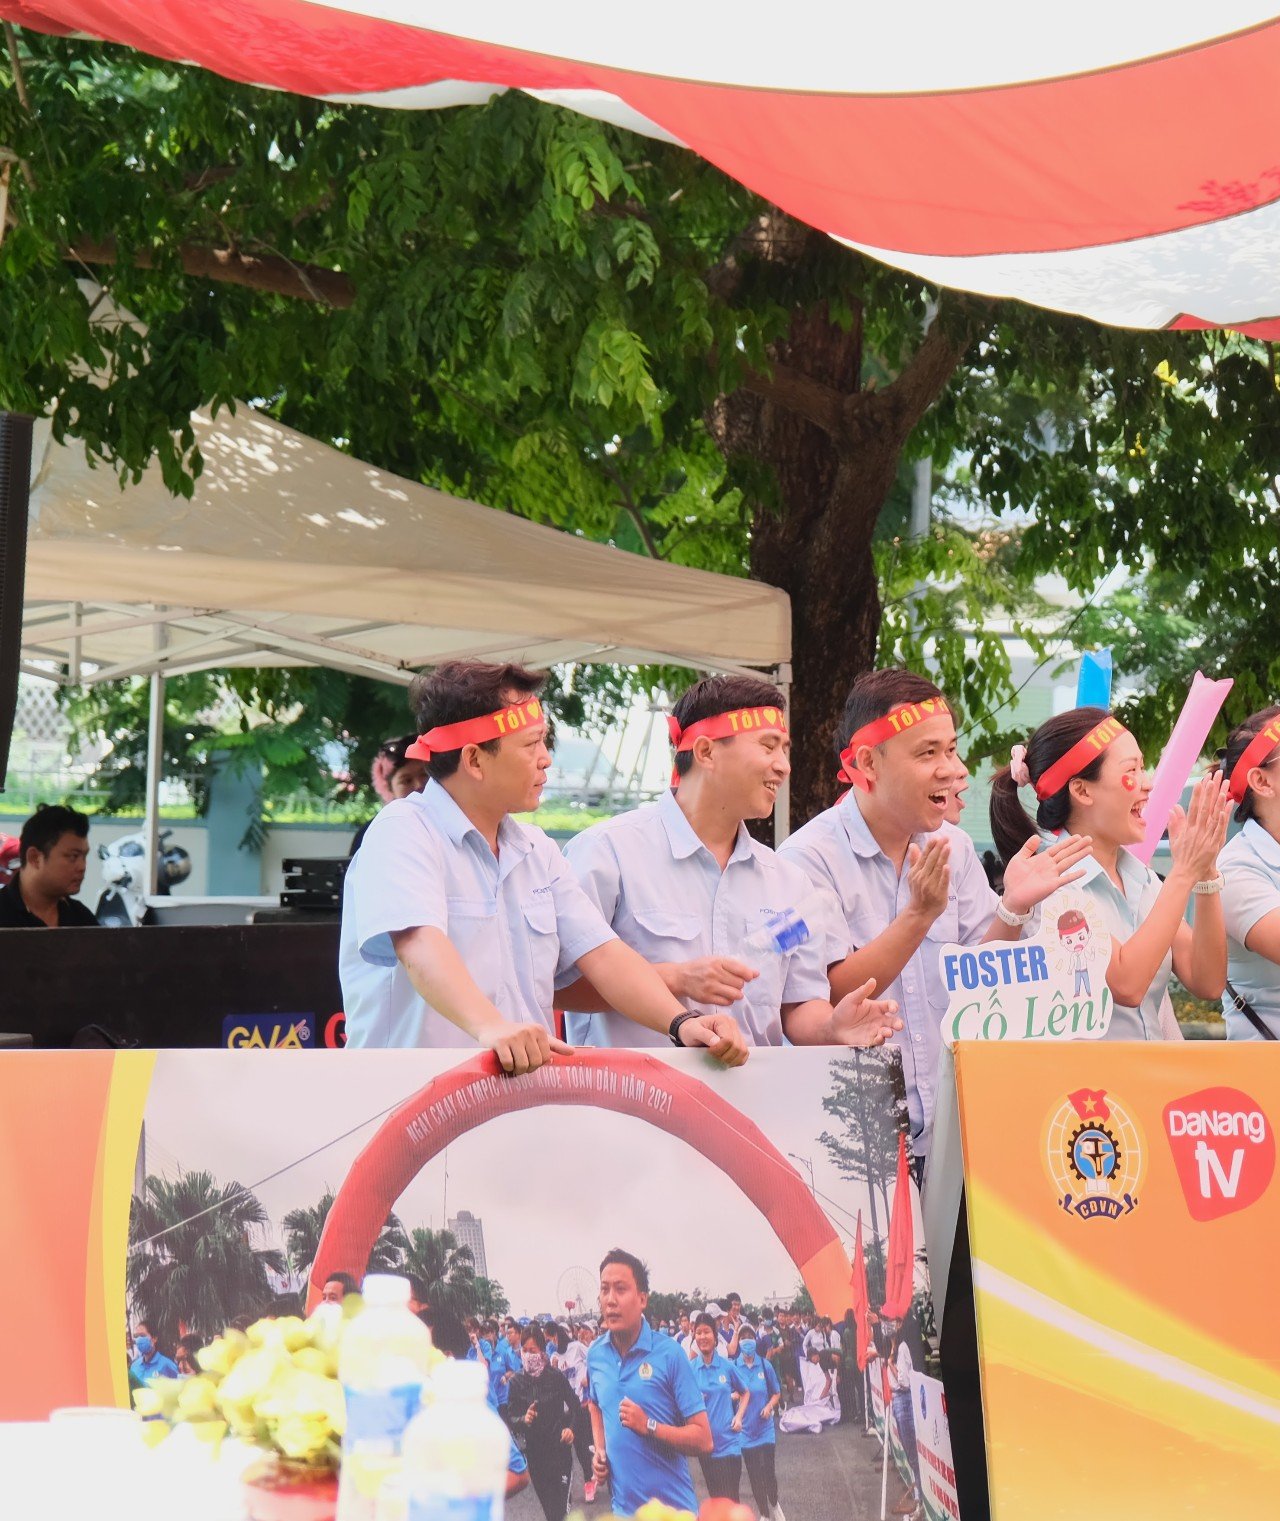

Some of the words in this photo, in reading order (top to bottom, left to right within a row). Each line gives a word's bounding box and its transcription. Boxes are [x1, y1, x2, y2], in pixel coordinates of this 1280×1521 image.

[944, 945, 1049, 991] FOSTER
[952, 989, 1008, 1040] Cố
[1022, 987, 1109, 1039] Lên!
[455, 1074, 500, 1112] OLYMPIC
[565, 1062, 593, 1090] TOÀN
[596, 1065, 616, 1094] DÂN
[621, 1073, 646, 1103] NĂM
[647, 1085, 673, 1115] 2021
[1169, 1109, 1266, 1143] DaNang
